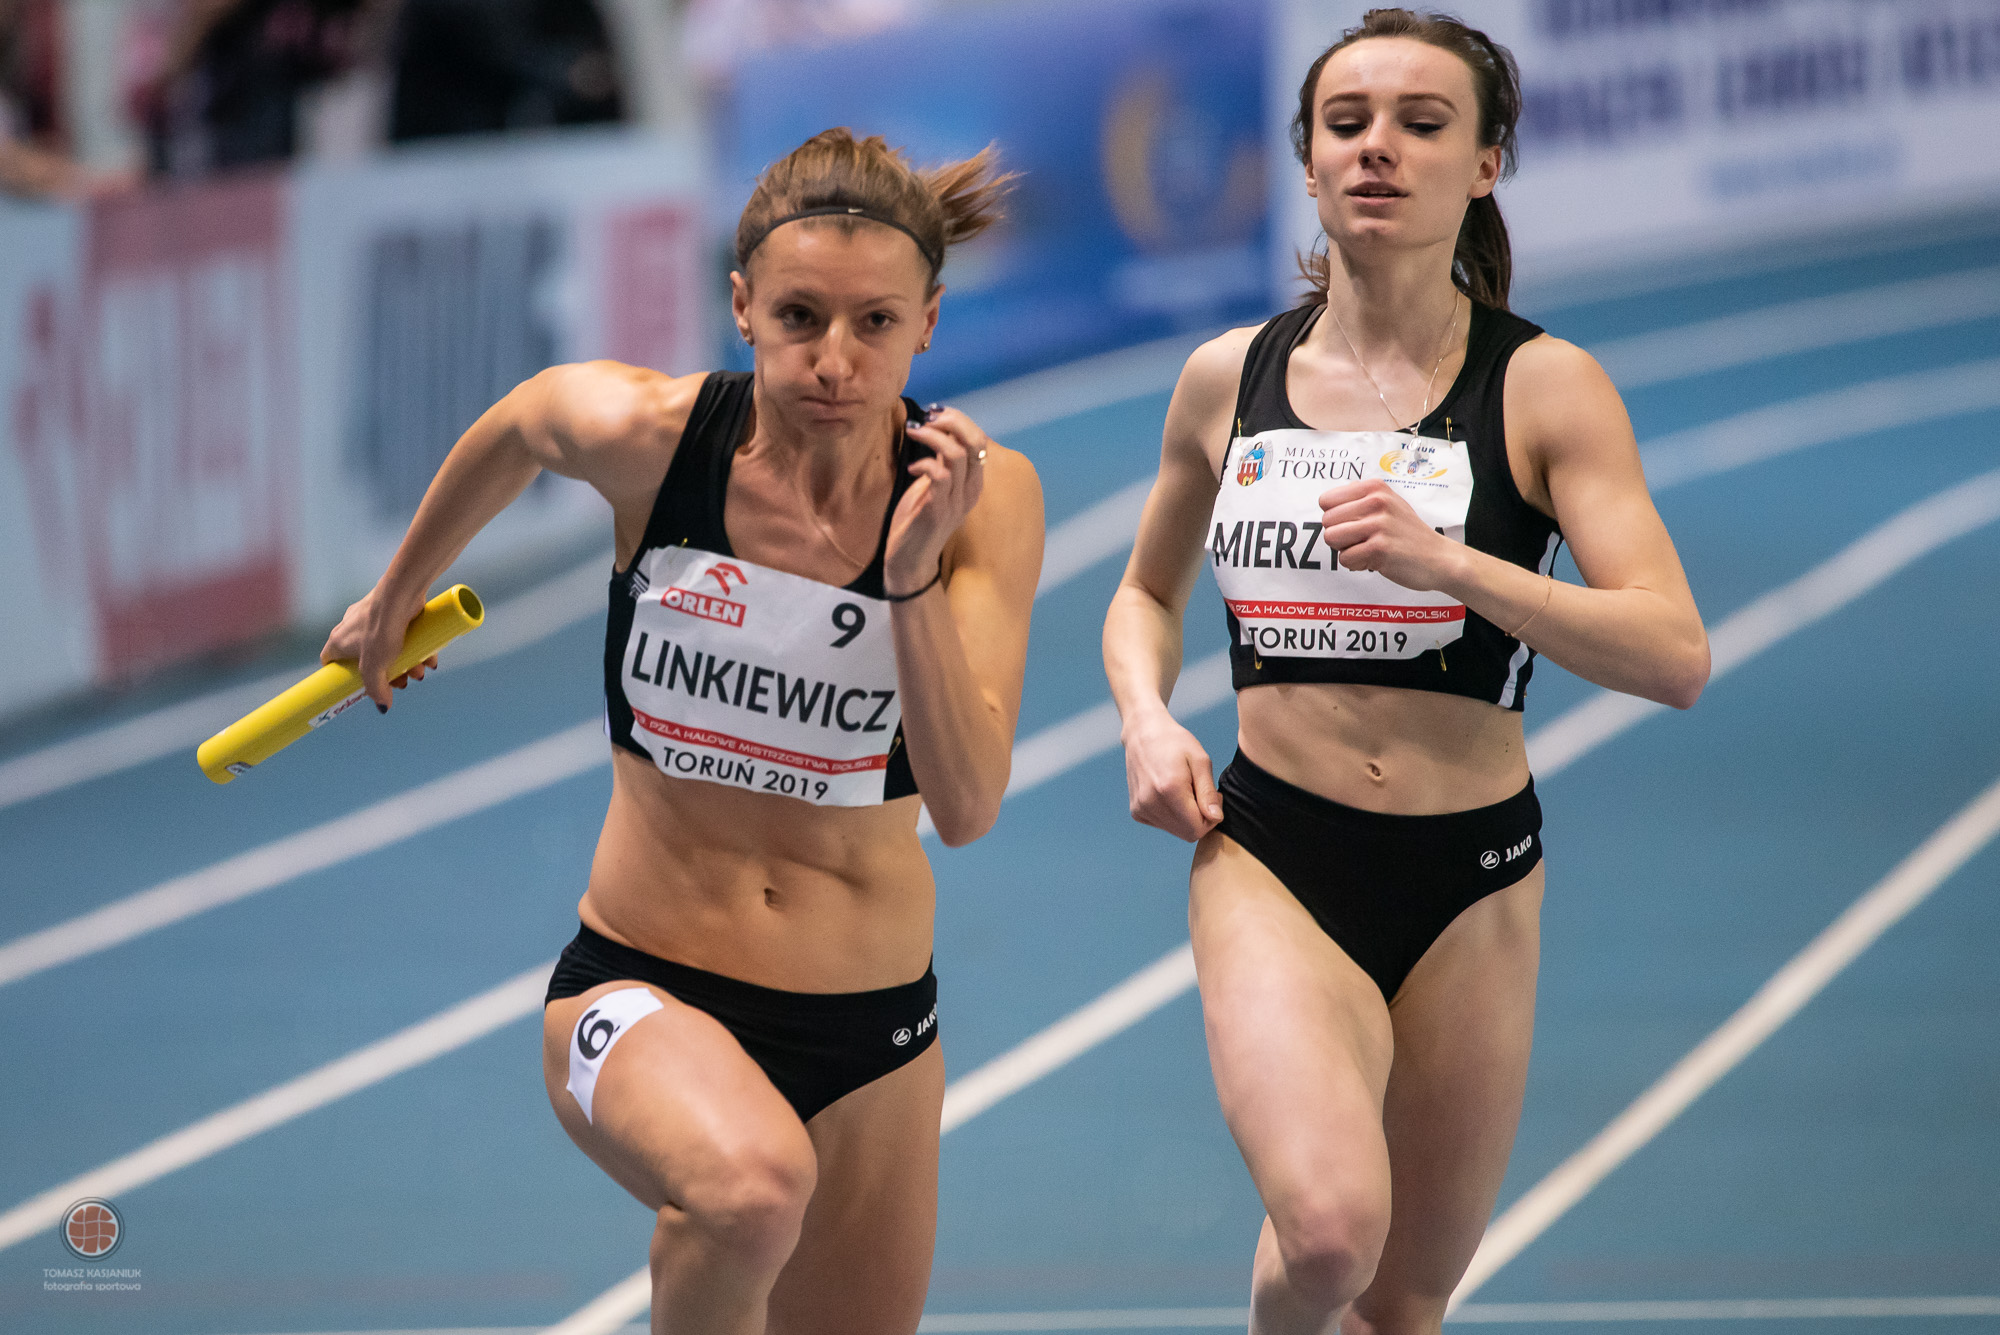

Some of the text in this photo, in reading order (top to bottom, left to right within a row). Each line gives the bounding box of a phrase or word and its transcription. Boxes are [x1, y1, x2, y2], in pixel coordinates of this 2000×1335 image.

[1278, 456, 1366, 480] TORUŃ
[1285, 447, 1349, 459] MIASTO
[664, 590, 742, 626] ORLEN
[829, 602, 866, 649] 9
[1263, 606, 1315, 616] HALOWE
[1317, 607, 1404, 619] MISTRZOSTWA
[1406, 610, 1450, 619] POLSKI
[1247, 621, 1408, 653] TORUŃ 2019
[630, 631, 896, 734] LINKIEWICZ
[649, 720, 873, 771] PZLA HALOWE MISTRZOSTWA POLSKI
[663, 746, 829, 800] TORUŃ 2019
[1505, 834, 1533, 862] JAKO
[577, 1009, 614, 1061] 6
